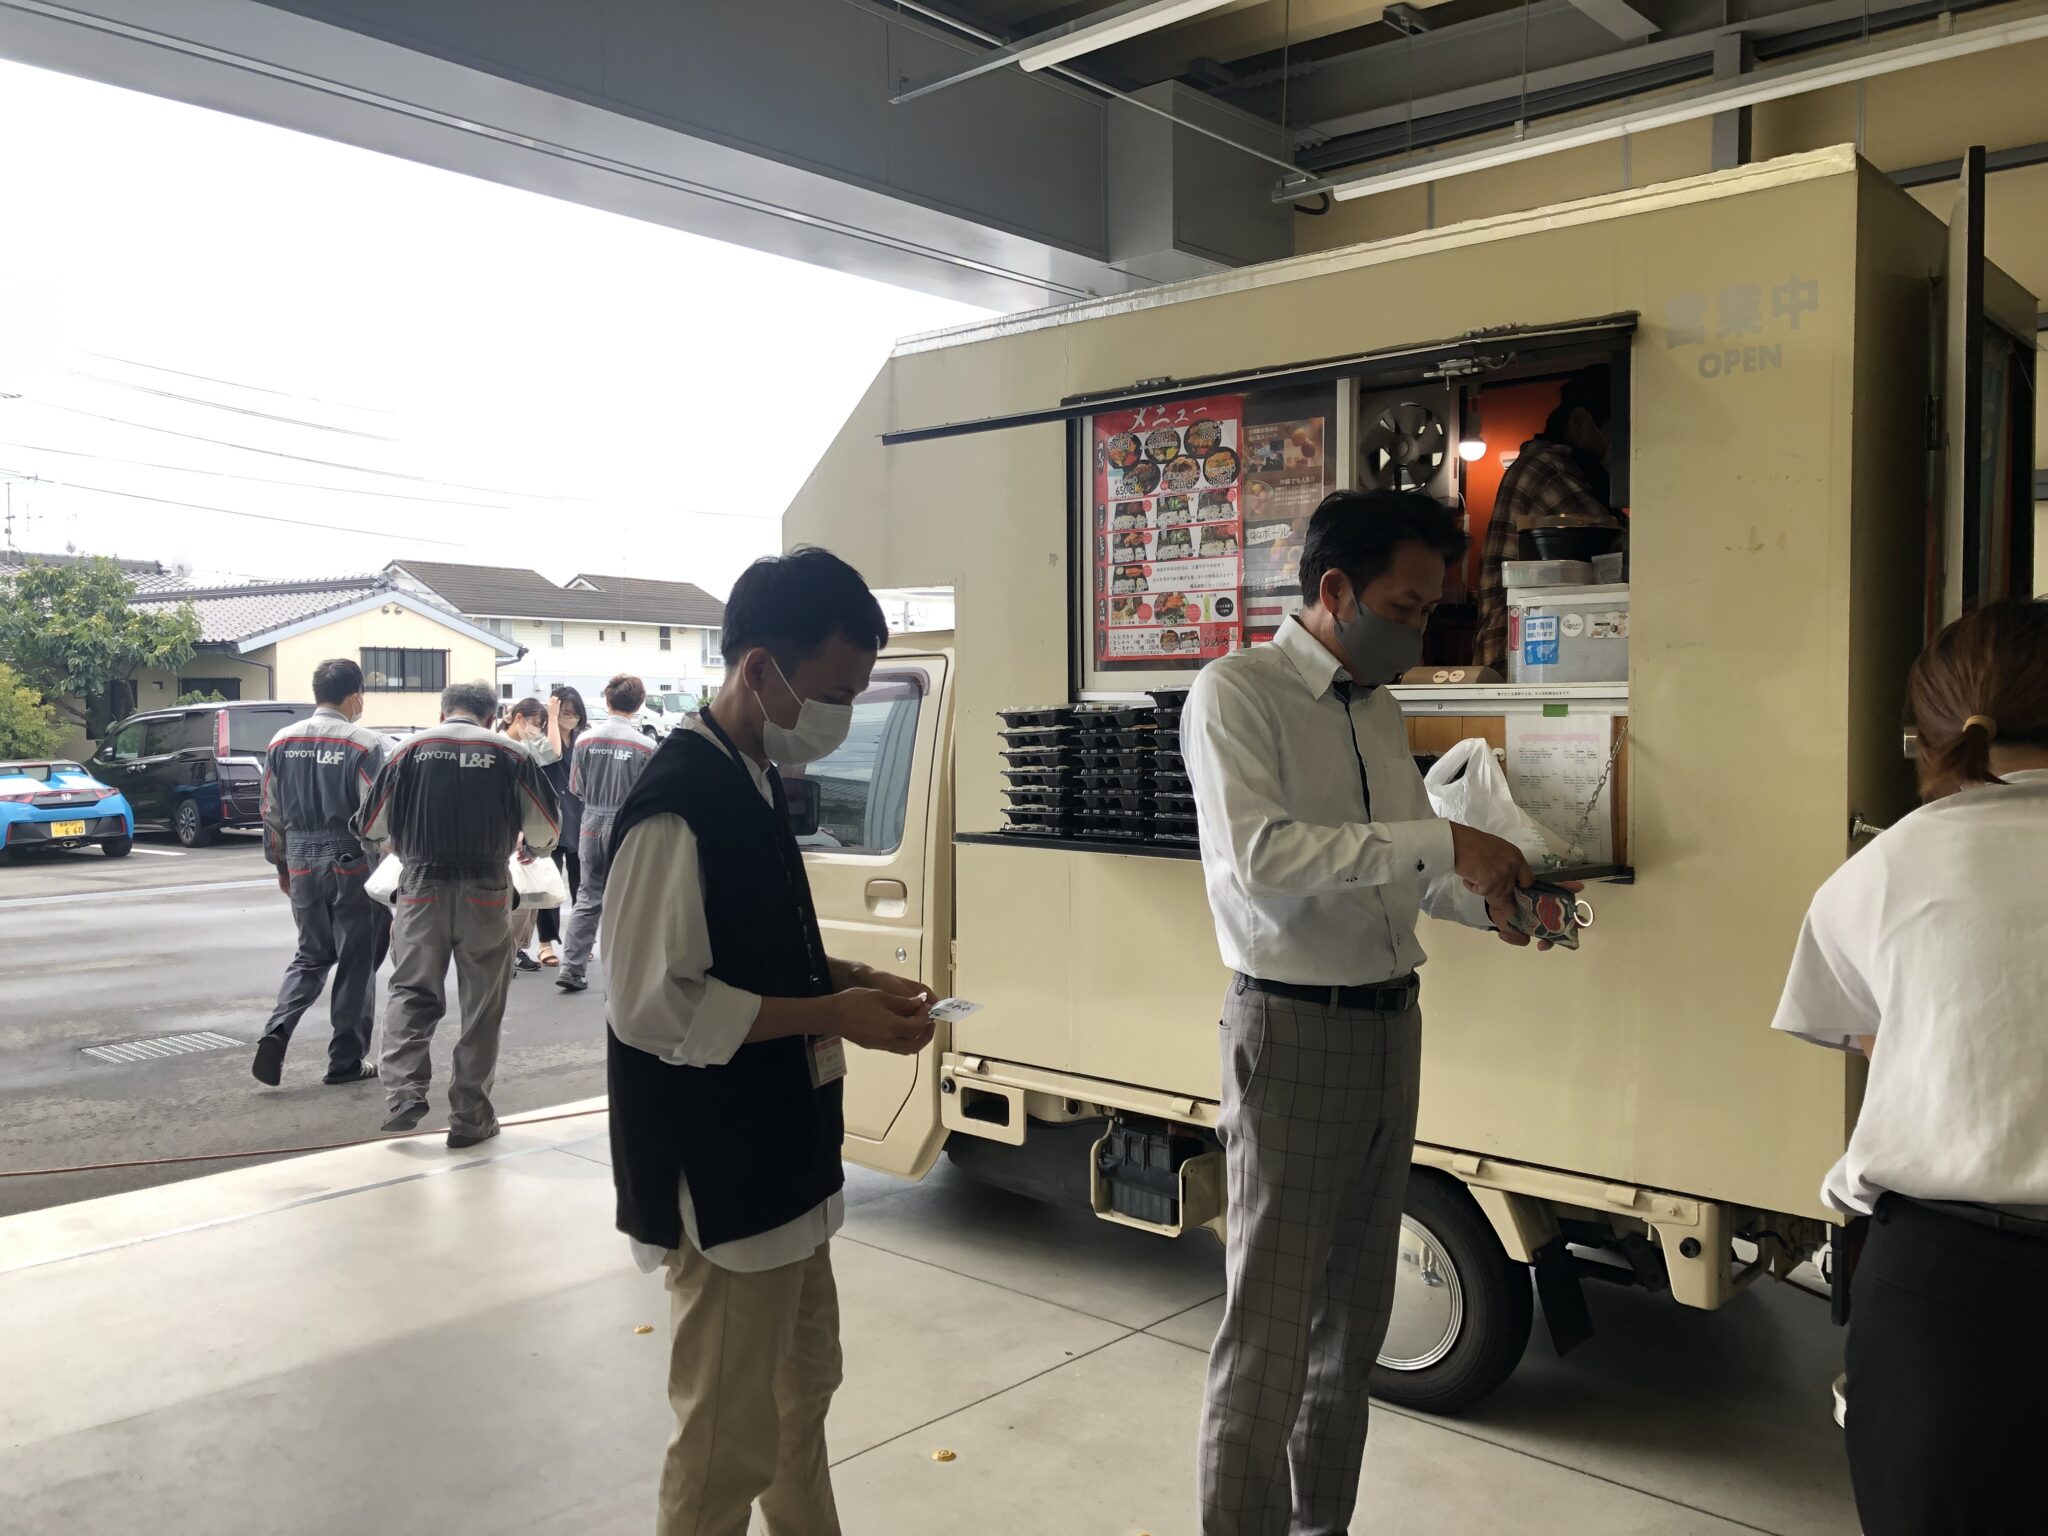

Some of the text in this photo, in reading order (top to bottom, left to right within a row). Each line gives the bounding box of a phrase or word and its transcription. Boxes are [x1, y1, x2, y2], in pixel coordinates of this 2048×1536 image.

[1698, 343, 1783, 379] OPEN
[1128, 404, 1208, 431] メニュー
[316, 749, 345, 765] L&F
[413, 750, 496, 769] TOYOTA L&F
